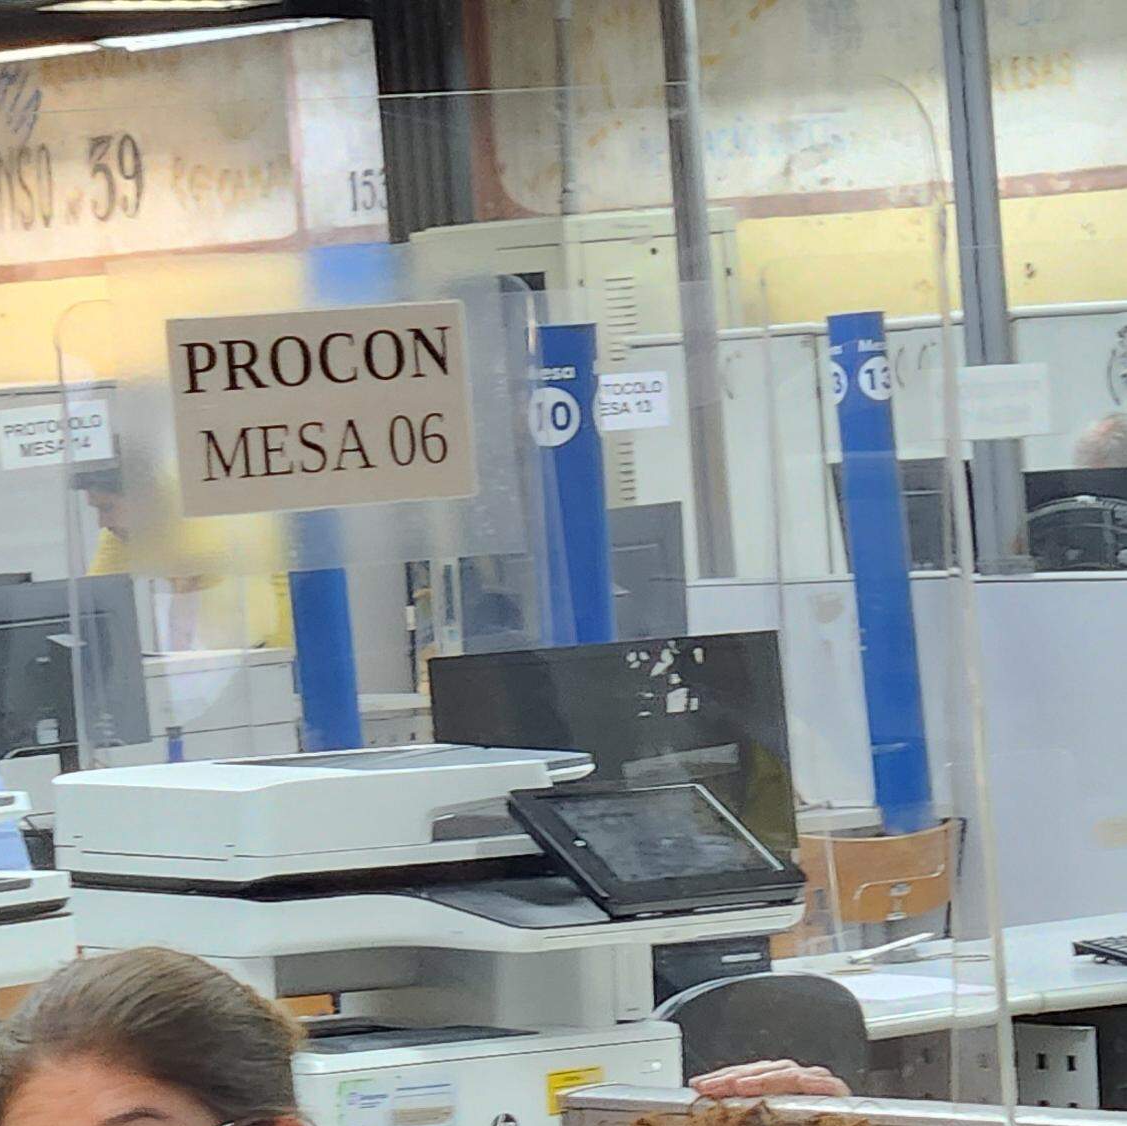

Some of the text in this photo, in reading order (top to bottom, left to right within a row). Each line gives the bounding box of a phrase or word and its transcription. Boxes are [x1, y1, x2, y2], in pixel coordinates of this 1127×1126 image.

[88, 132, 144, 222] 39
[178, 326, 451, 394] PROCON
[530, 364, 576, 381] esa
[864, 366, 892, 391] 13
[598, 401, 631, 416] ESA
[3, 414, 103, 437] PROTOOLO
[199, 412, 449, 482] MESA 06
